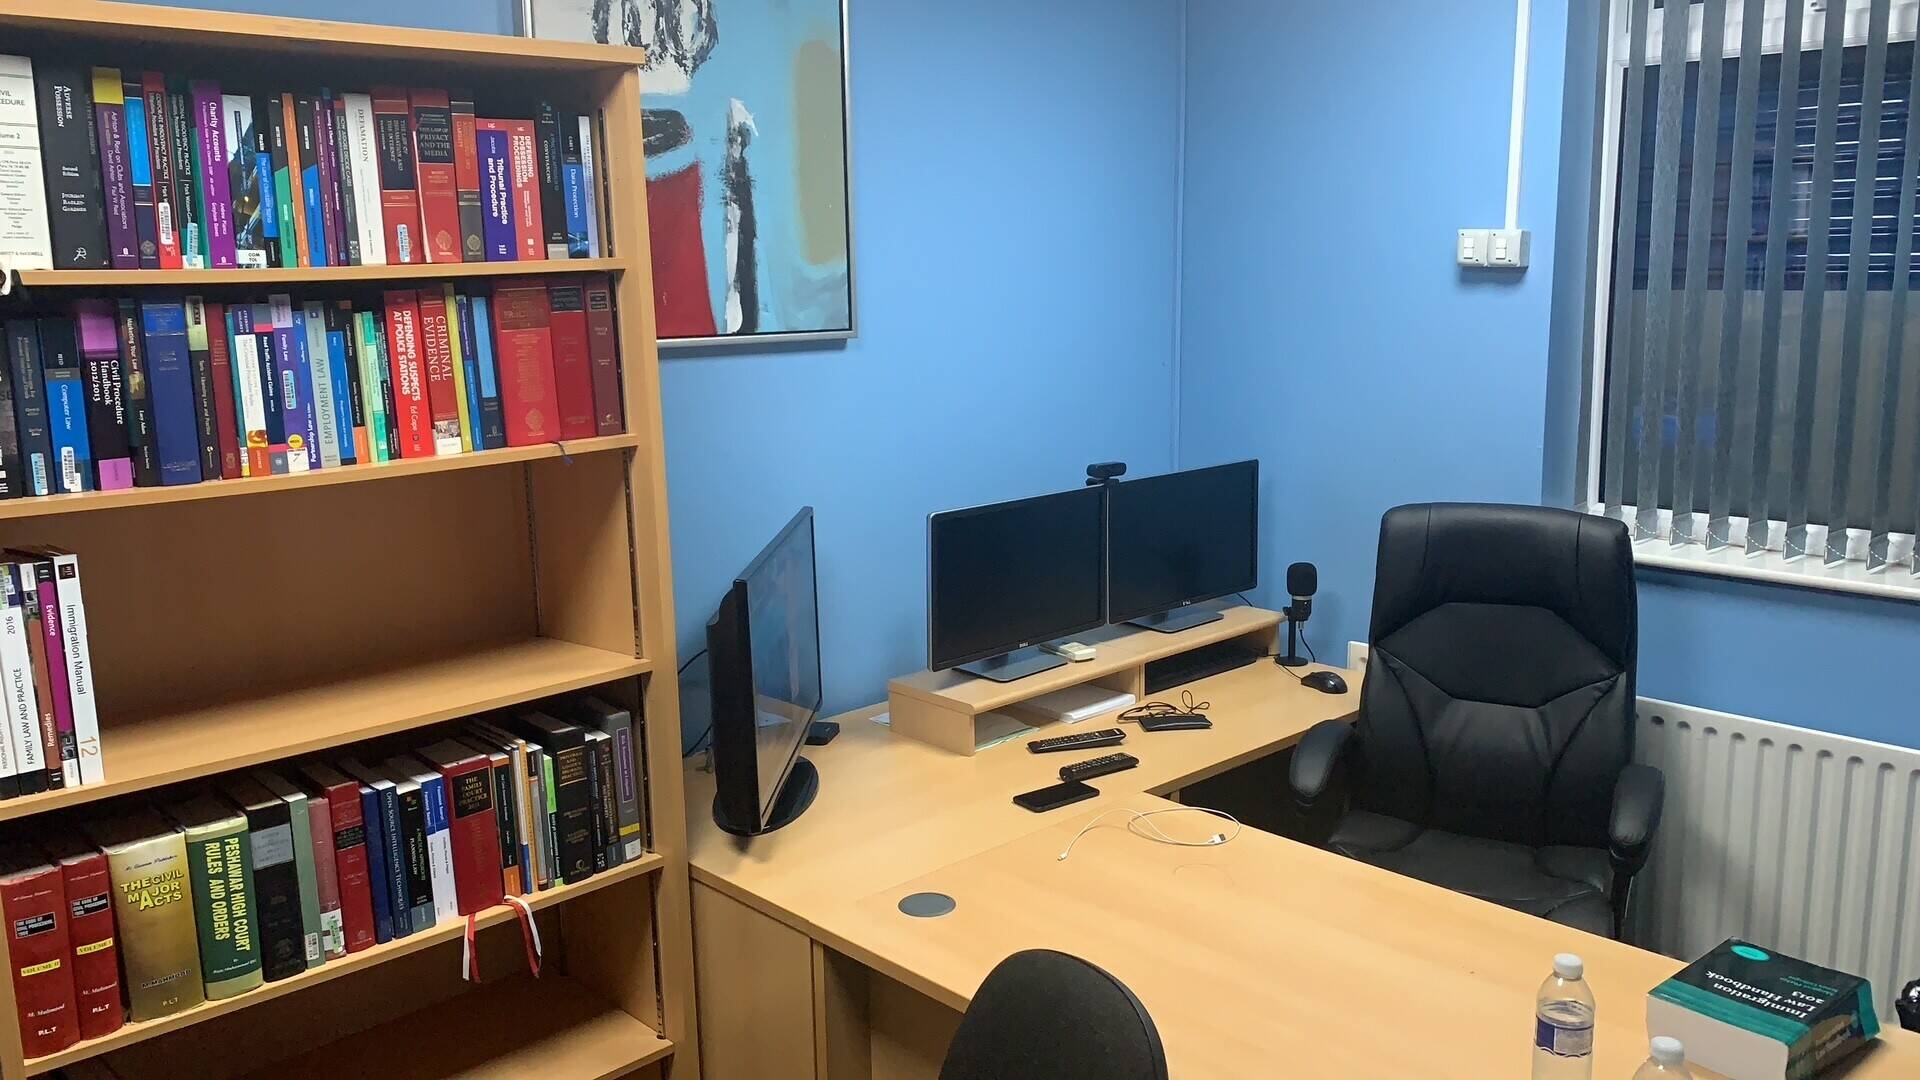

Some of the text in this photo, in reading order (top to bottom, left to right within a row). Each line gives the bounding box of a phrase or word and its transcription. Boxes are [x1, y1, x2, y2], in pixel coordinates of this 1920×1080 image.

[54, 85, 65, 128] POSSESSION
[63, 86, 73, 120] ADVERSE
[111, 111, 119, 133] Ashton
[180, 120, 189, 152] INSOLVENCY
[209, 101, 222, 162] Charity Accounts
[357, 109, 369, 162] DEFAMATION
[158, 123, 167, 155] INSOLVENCY
[388, 133, 396, 162] INTERNET
[424, 149, 448, 157] MEDIA
[115, 155, 121, 163] on
[116, 164, 125, 181] Clubs
[161, 156, 169, 180] PRACTICE
[183, 152, 192, 176] PRACTICE
[513, 136, 523, 188] PROCEEDINGS
[519, 136, 528, 183] POSSESSION
[525, 136, 534, 178] DEFENDING
[543, 140, 552, 183] CONVEYANCING
[118, 182, 126, 194] and
[487, 158, 499, 218] and Procedure
[496, 158, 509, 225] Tribunal Practice
[570, 168, 580, 218] Data Protection
[120, 195, 129, 230] Associations
[126, 318, 135, 344] Marketing
[393, 311, 411, 395] AT POLICE STATIONS
[402, 310, 421, 401] DEFENDING SUSPECTS
[423, 317, 441, 382] EVIDENCE
[435, 315, 452, 381] CRIMINAL
[90, 361, 101, 402] 2012/2013
[100, 361, 112, 406] Handbook
[110, 360, 124, 425] Civil Procedure
[60, 384, 72, 430] Computer Law
[138, 410, 146, 421] Lucy
[316, 358, 334, 445] EMPLOYMENT LAW
[410, 405, 417, 414] Ed
[307, 432, 317, 463] Partnership
[6, 616, 16, 635] 2016
[46, 604, 57, 637] Evidence
[66, 604, 87, 695] Immigration Manual
[13, 668, 35, 765] FAMILY LAW AND PRACTICE
[44, 712, 55, 747] Remedies
[80, 735, 98, 758] 12
[462, 788, 483, 798] COURT
[465, 776, 478, 784] THE
[459, 793, 487, 806] PRACTICE
[224, 837, 244, 892] PESHAWAR
[386, 791, 405, 911] OPEN SOURCE INTELLIGENCE TECHNIQUES
[120, 868, 184, 893] THE CIVIL
[127, 881, 181, 911] MAJOR
[204, 841, 230, 942] RULES AND ORDERS
[139, 889, 182, 911] ACTS
[231, 892, 246, 918] HIGH
[78, 941, 106, 954] VOLUME
[233, 918, 251, 952] COURT
[22, 962, 53, 975] VOLUME
[1705, 970, 1781, 1002] Handbook
[1712, 982, 1808, 1019] Immigration
[1791, 990, 1825, 1004] 2013
[1784, 998, 1817, 1012] Law
